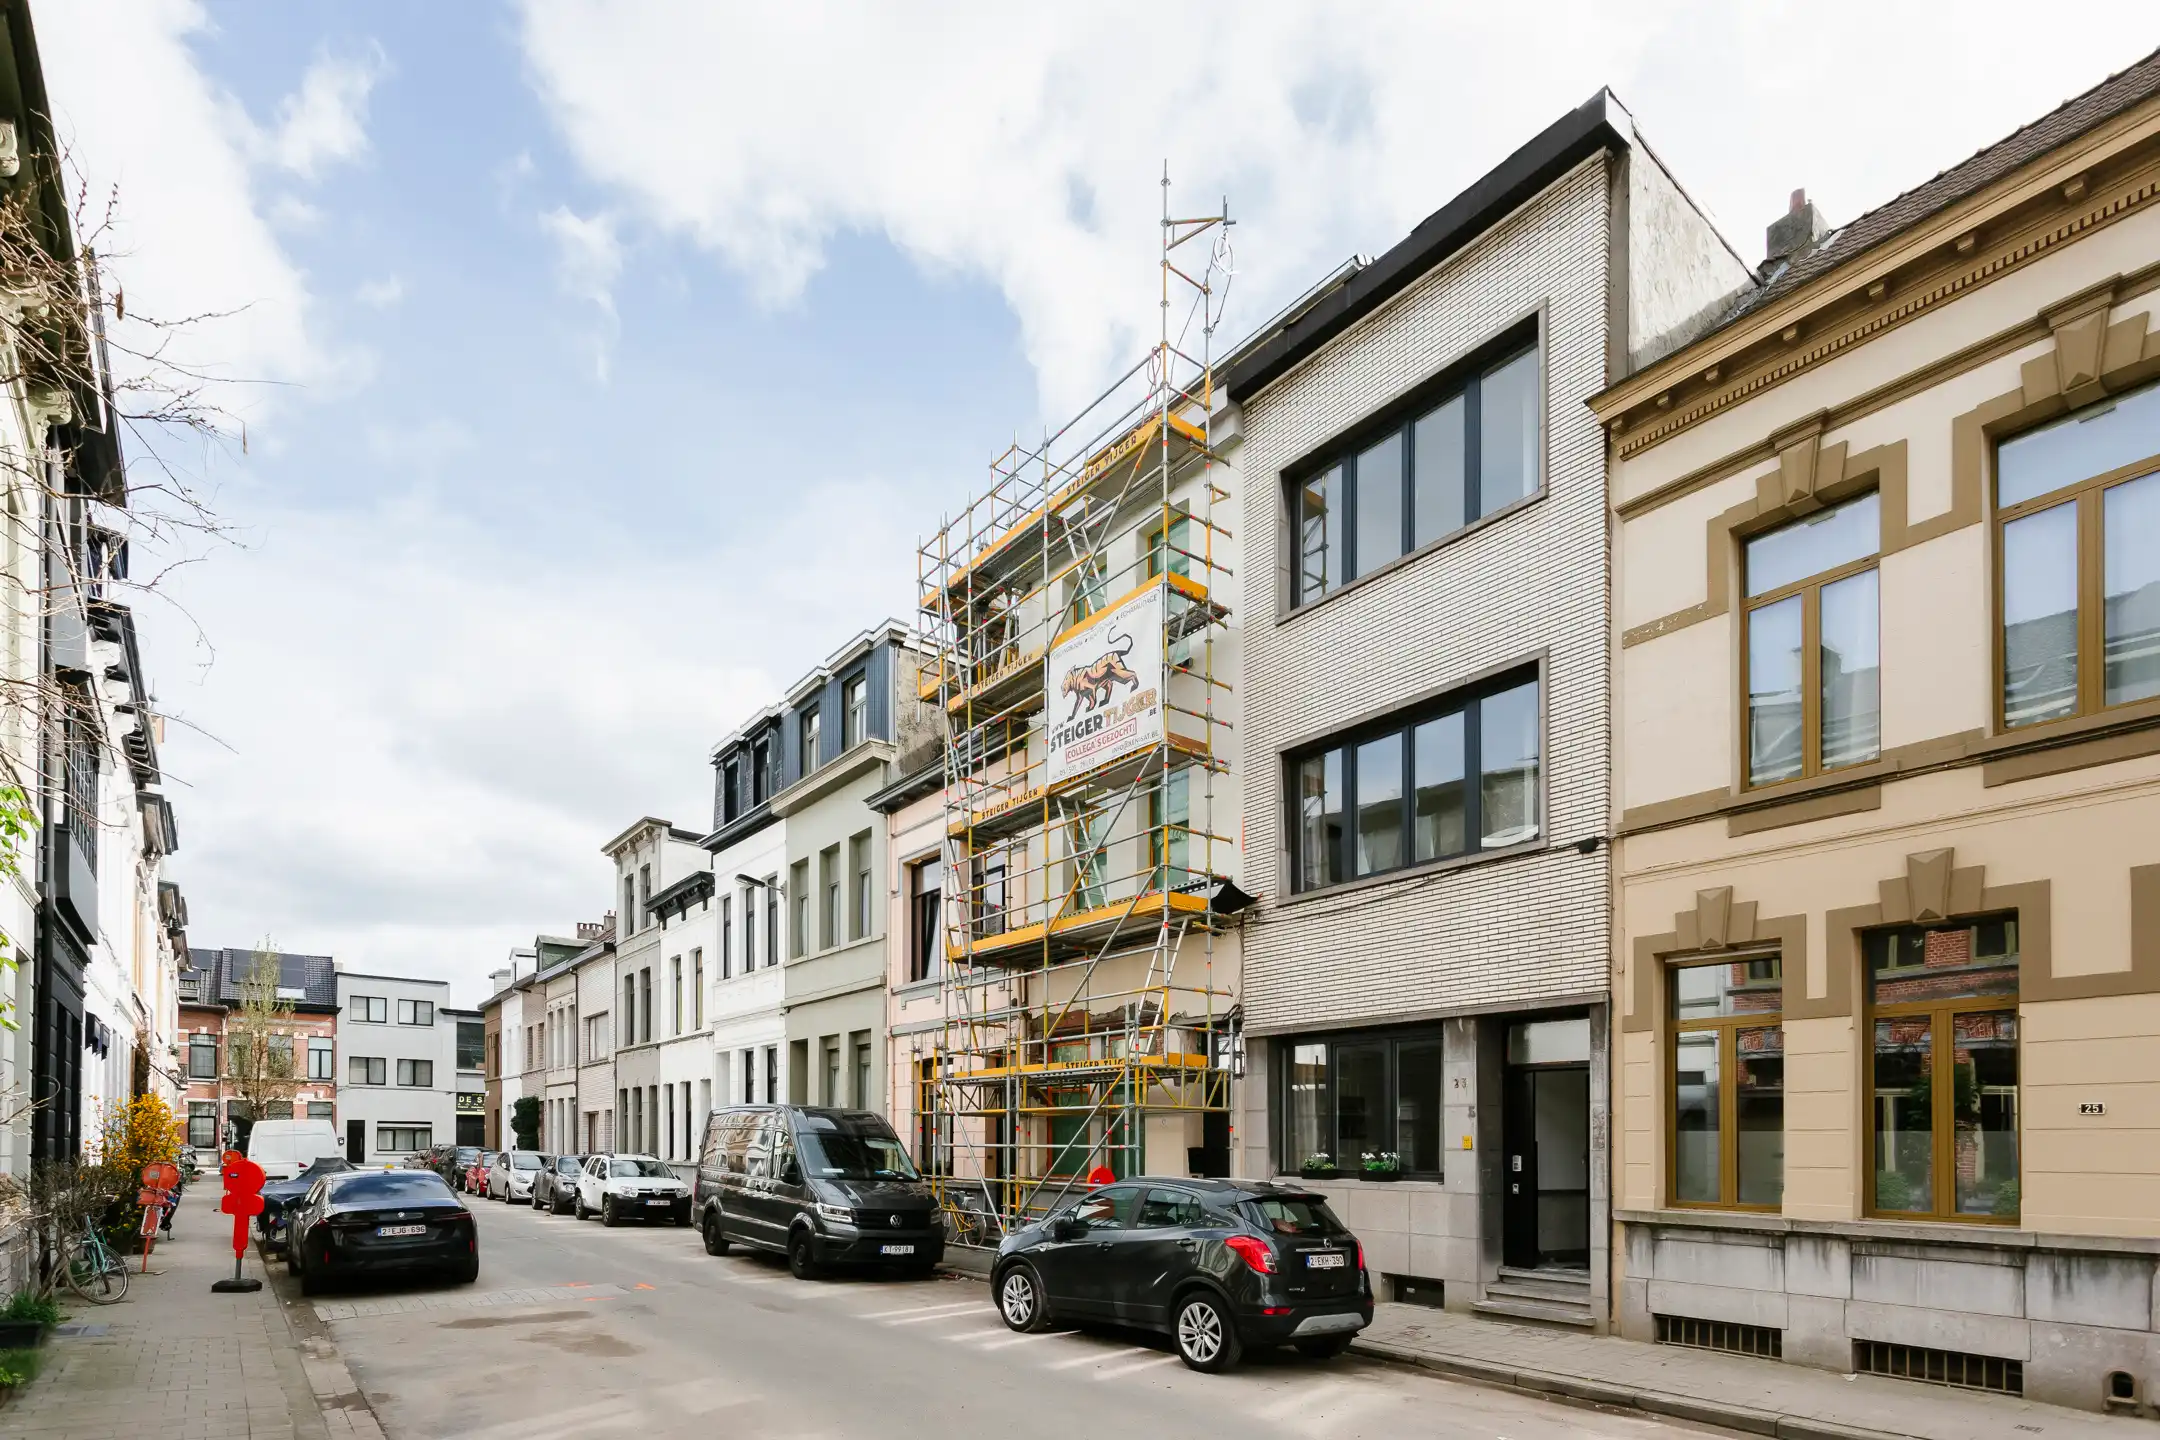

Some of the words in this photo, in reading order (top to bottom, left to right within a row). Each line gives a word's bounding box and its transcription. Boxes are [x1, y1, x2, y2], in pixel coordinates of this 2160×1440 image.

[1066, 463, 1100, 496] STEIGER
[1104, 435, 1137, 465] TIJGER
[976, 670, 1004, 691] STEIGER
[1067, 738, 1102, 759] COLLEGA'S
[1102, 722, 1136, 748] GEZOCHT!
[981, 801, 1009, 820] STEIGER
[1012, 788, 1038, 806] TIJGER
[459, 1095, 472, 1103] DE
[2085, 1104, 2099, 1113] 25
